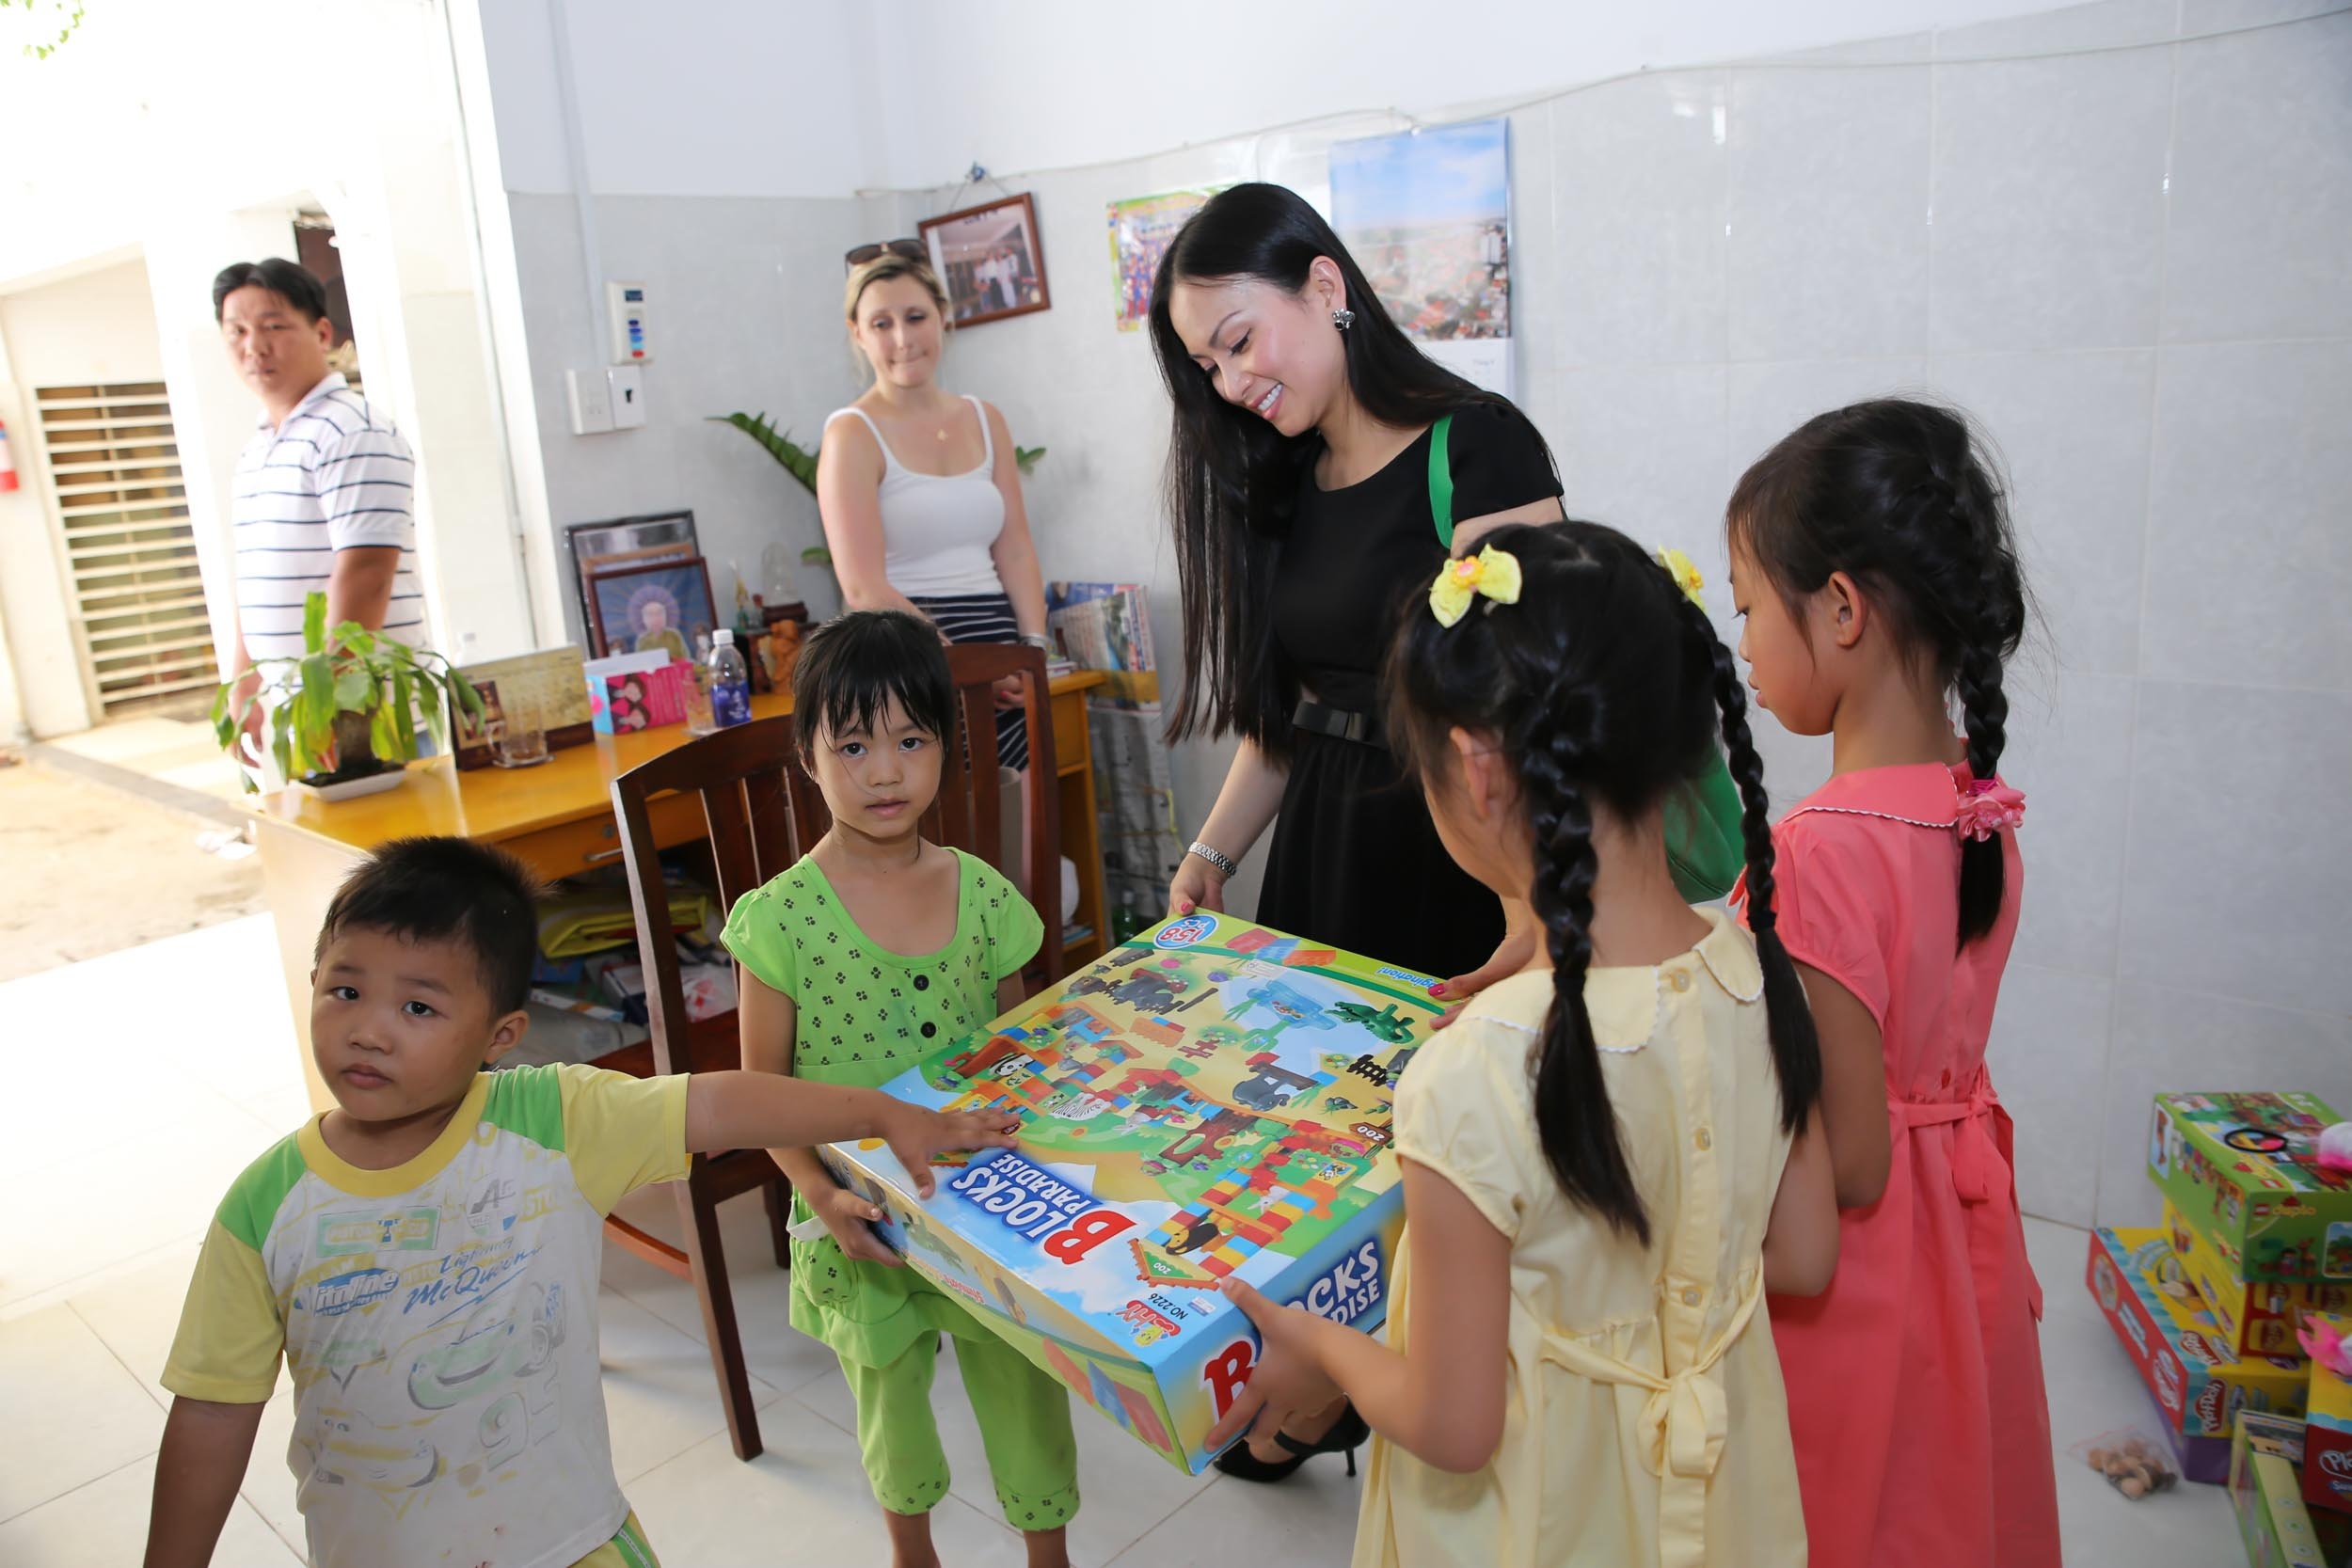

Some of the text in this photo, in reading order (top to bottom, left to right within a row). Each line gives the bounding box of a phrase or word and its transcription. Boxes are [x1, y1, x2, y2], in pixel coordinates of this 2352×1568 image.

[1159, 927, 1203, 943] 158
[990, 1153, 1091, 1214] PARADISE
[1149, 1292, 1189, 1321] NO.2226
